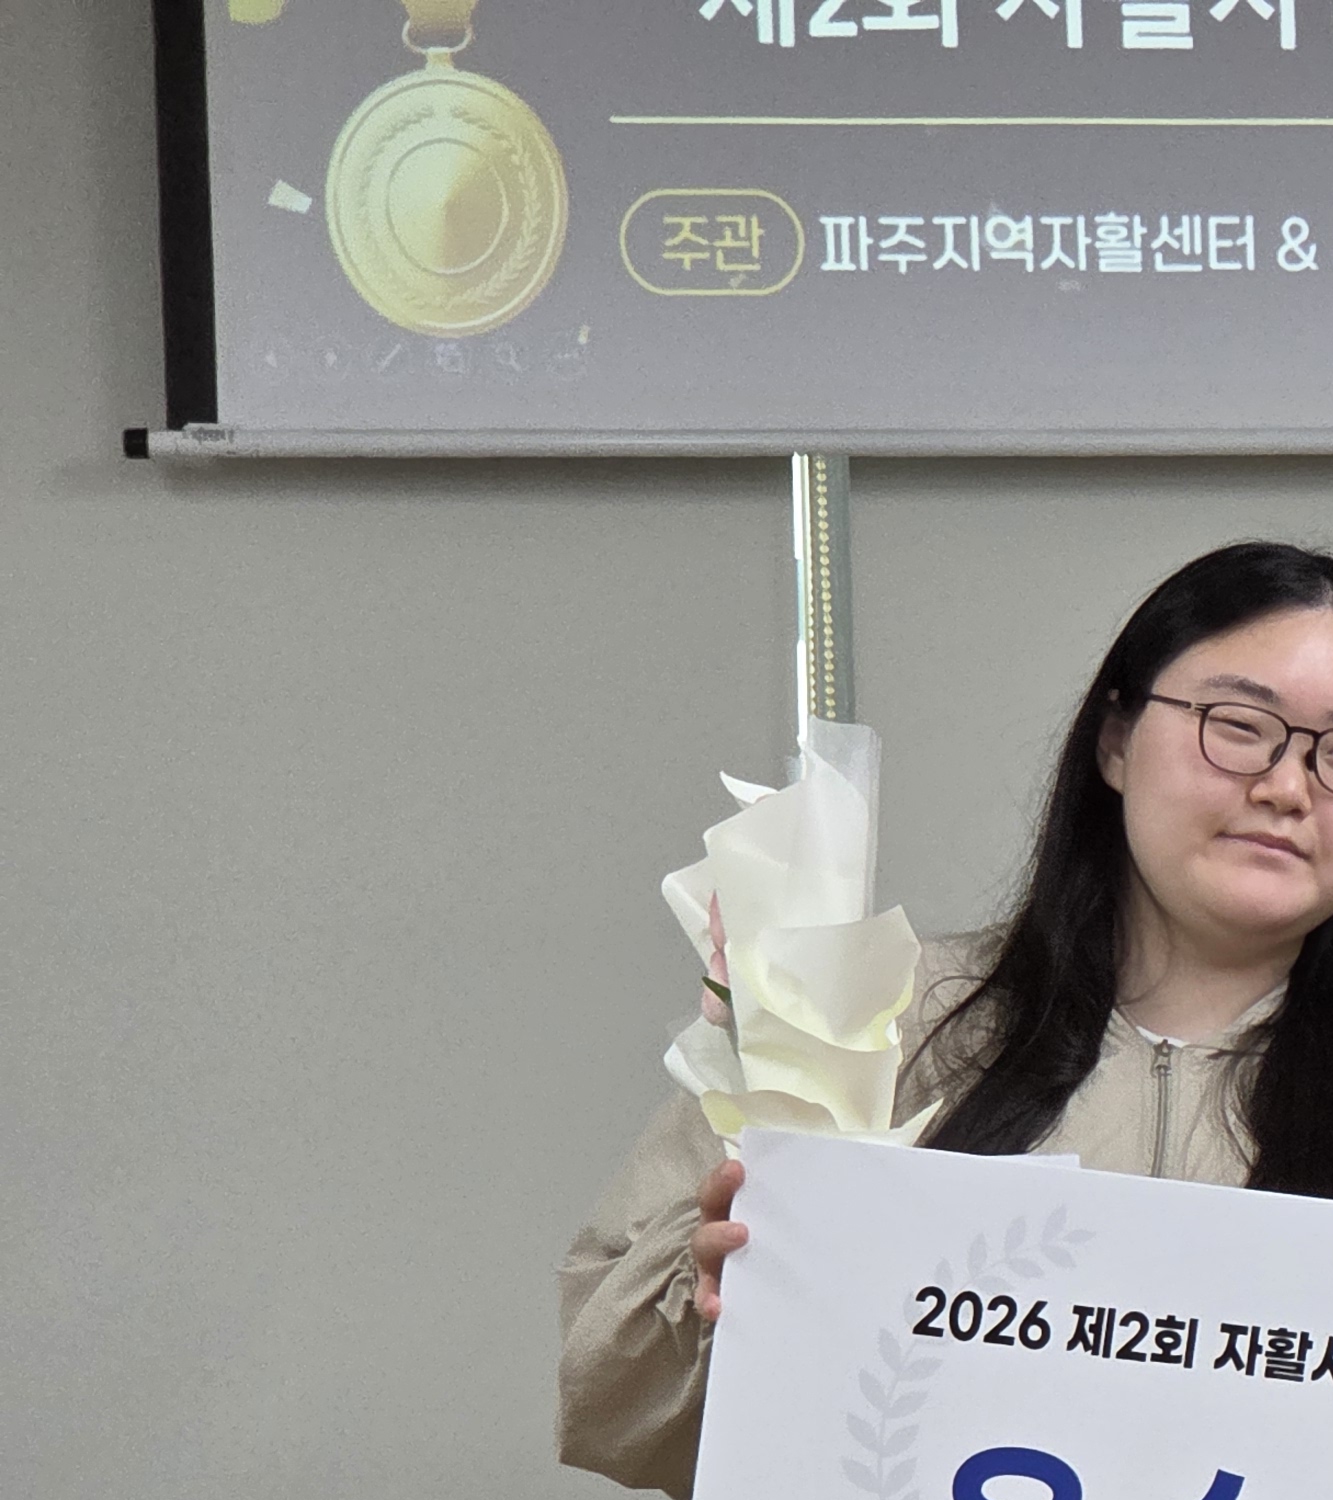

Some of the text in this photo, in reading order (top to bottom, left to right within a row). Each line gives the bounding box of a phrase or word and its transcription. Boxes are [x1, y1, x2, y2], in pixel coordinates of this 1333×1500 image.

[665, 214, 763, 271] 주관
[819, 212, 1256, 274] 파주지역자활센터
[1276, 215, 1319, 272] &
[912, 1286, 1051, 1350] 2026
[1066, 1305, 1199, 1369] 제2회
